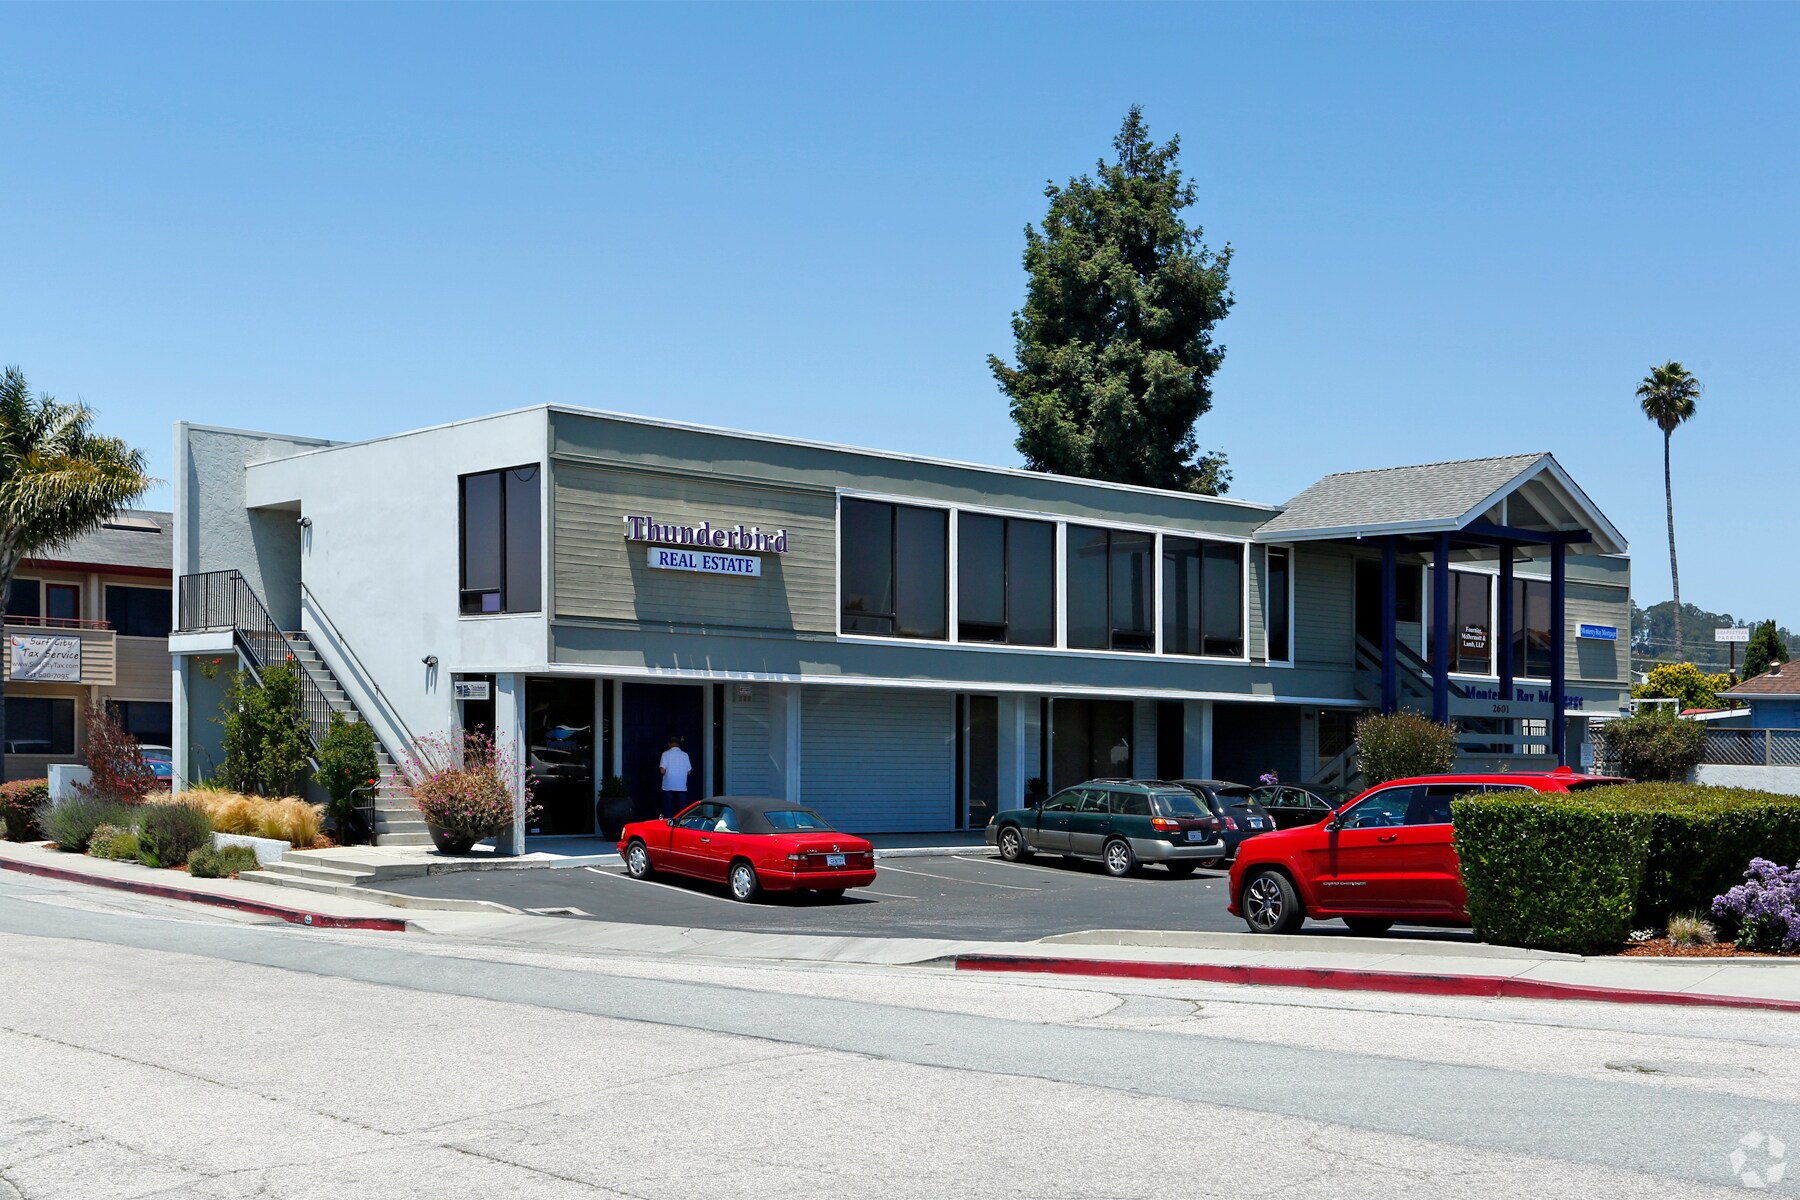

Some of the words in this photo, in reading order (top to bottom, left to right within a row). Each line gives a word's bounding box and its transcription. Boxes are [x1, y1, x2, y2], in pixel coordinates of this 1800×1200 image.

[626, 515, 788, 553] Thunderbird
[659, 551, 697, 568] REAL
[703, 555, 754, 573] ESTATE
[30, 637, 50, 645] Surf
[54, 639, 73, 648] City
[23, 648, 39, 658] Tax
[44, 649, 79, 660] Service
[1465, 685, 1500, 700] Monte
[1492, 704, 1510, 714] 2601
